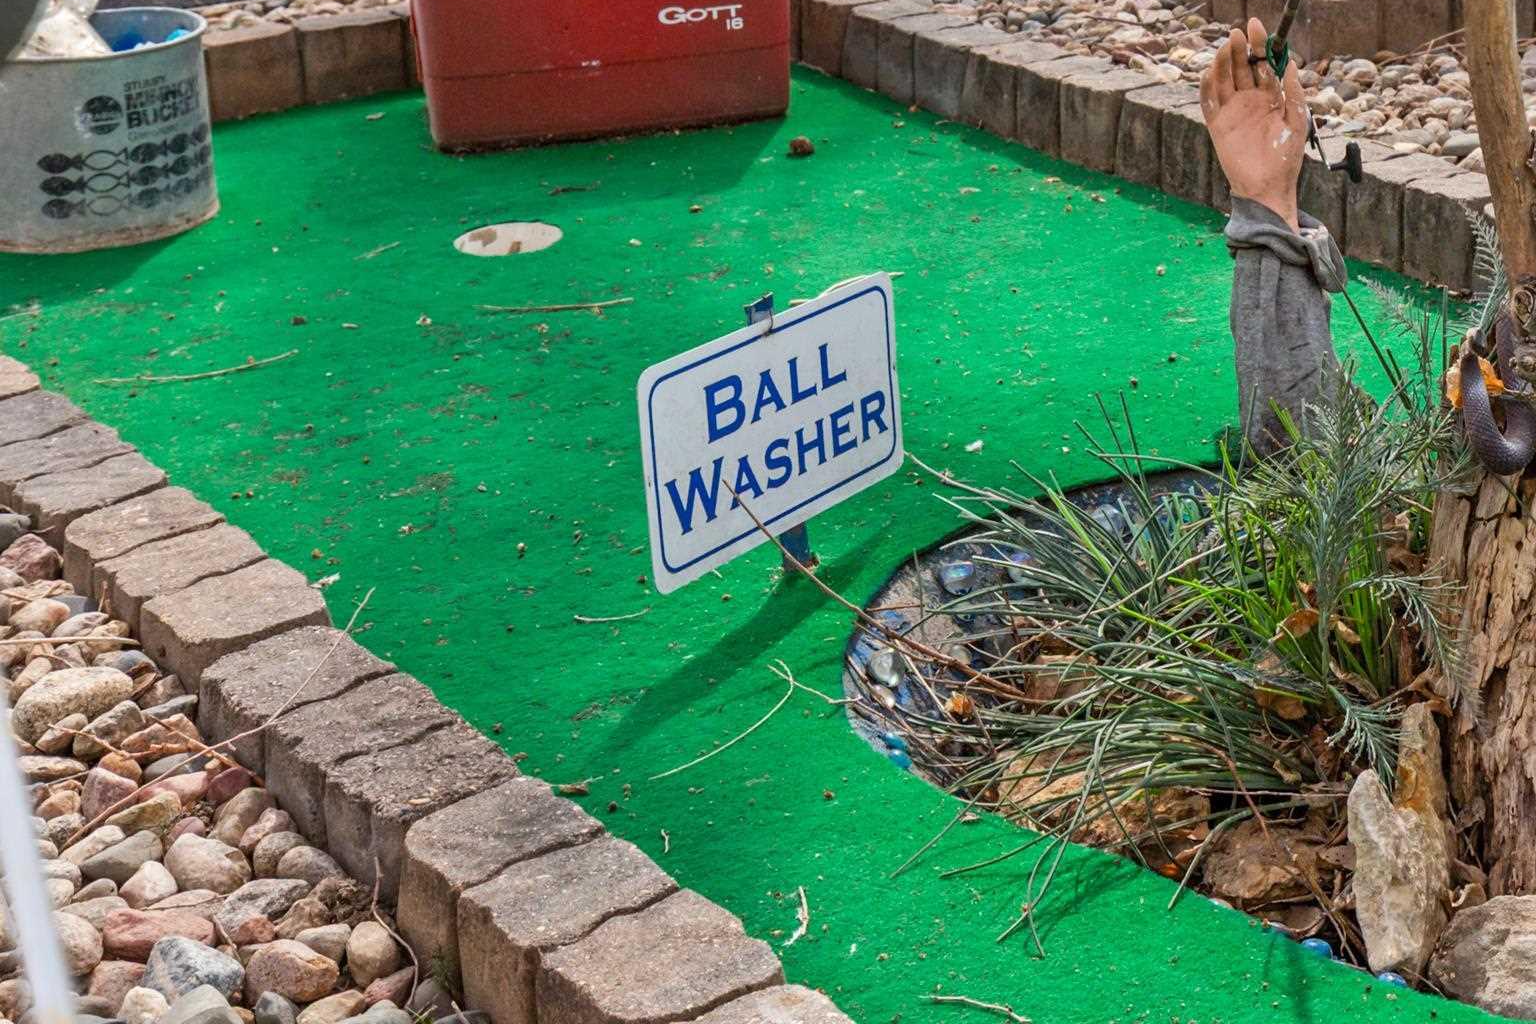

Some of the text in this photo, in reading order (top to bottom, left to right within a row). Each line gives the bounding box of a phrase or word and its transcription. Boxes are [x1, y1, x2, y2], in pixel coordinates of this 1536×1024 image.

[658, 4, 742, 25] GOTT
[726, 17, 744, 30] 16
[703, 343, 847, 444] BALL
[664, 390, 889, 536] WASHER
